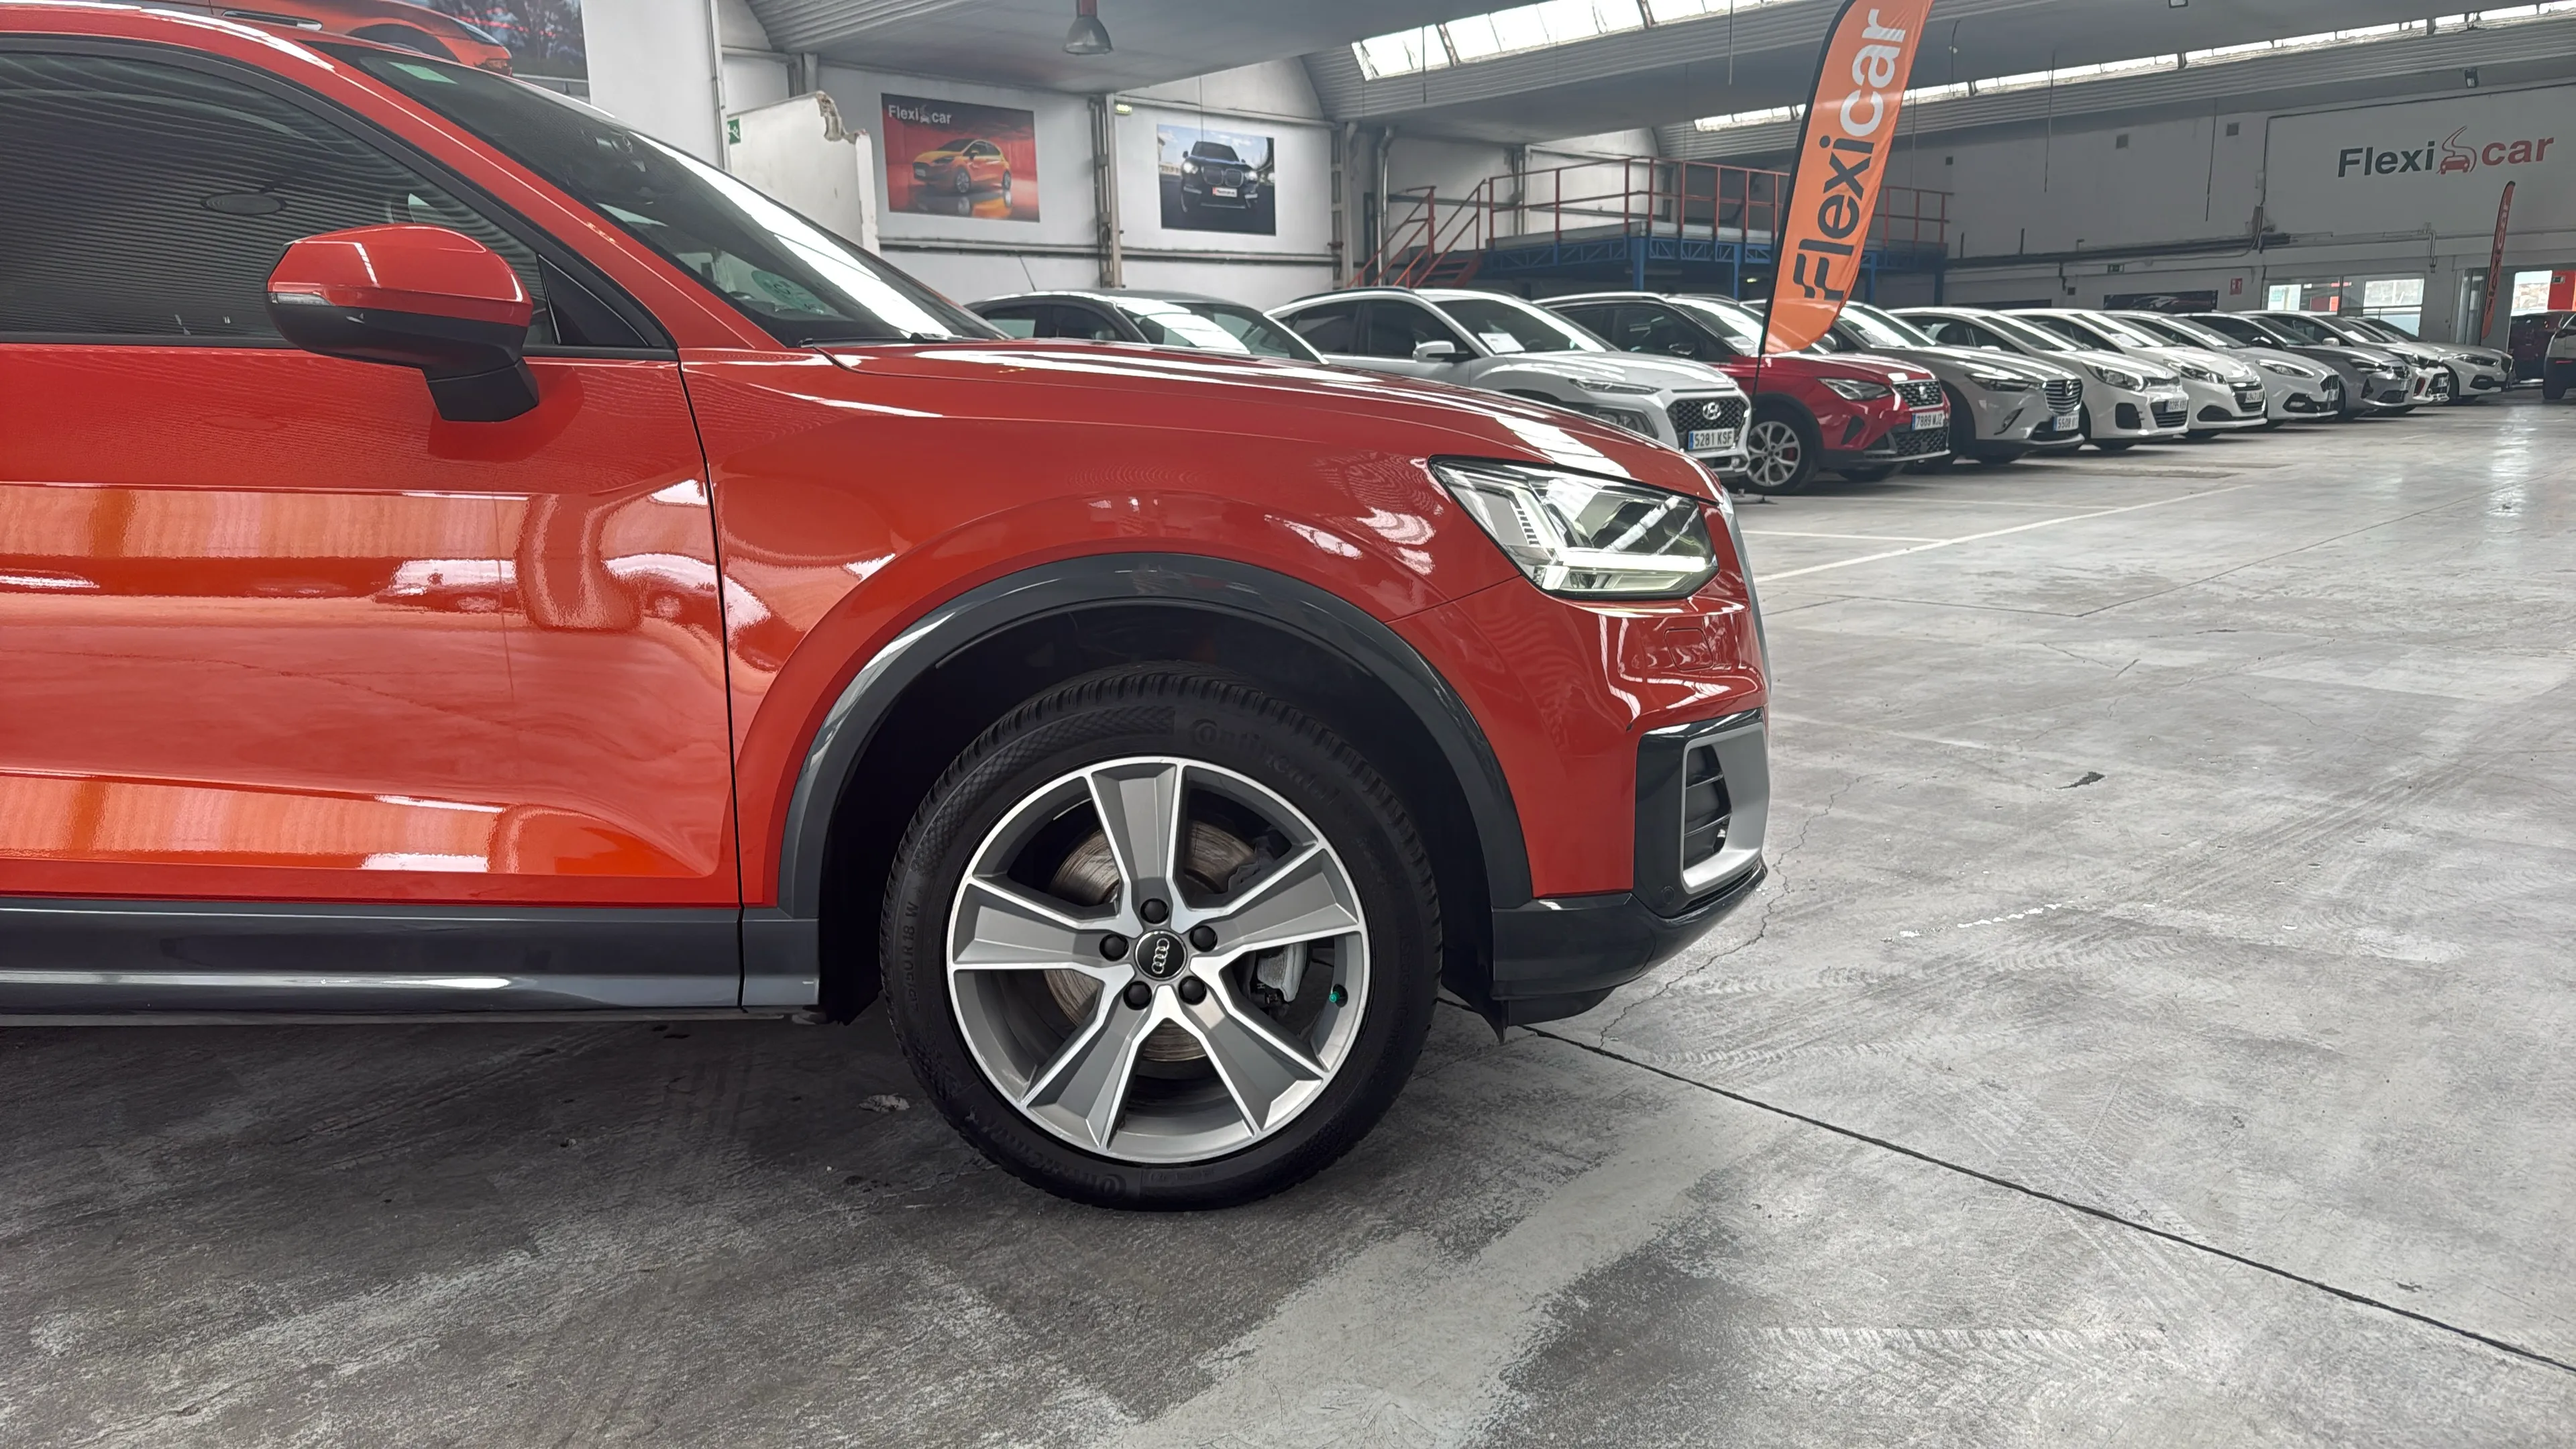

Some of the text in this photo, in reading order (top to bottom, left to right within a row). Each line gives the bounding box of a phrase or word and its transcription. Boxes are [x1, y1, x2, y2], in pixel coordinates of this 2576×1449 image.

[1792, 9, 1907, 301] Flexicar
[1695, 431, 1732, 447] 5281 KSF
[905, 900, 920, 917] W
